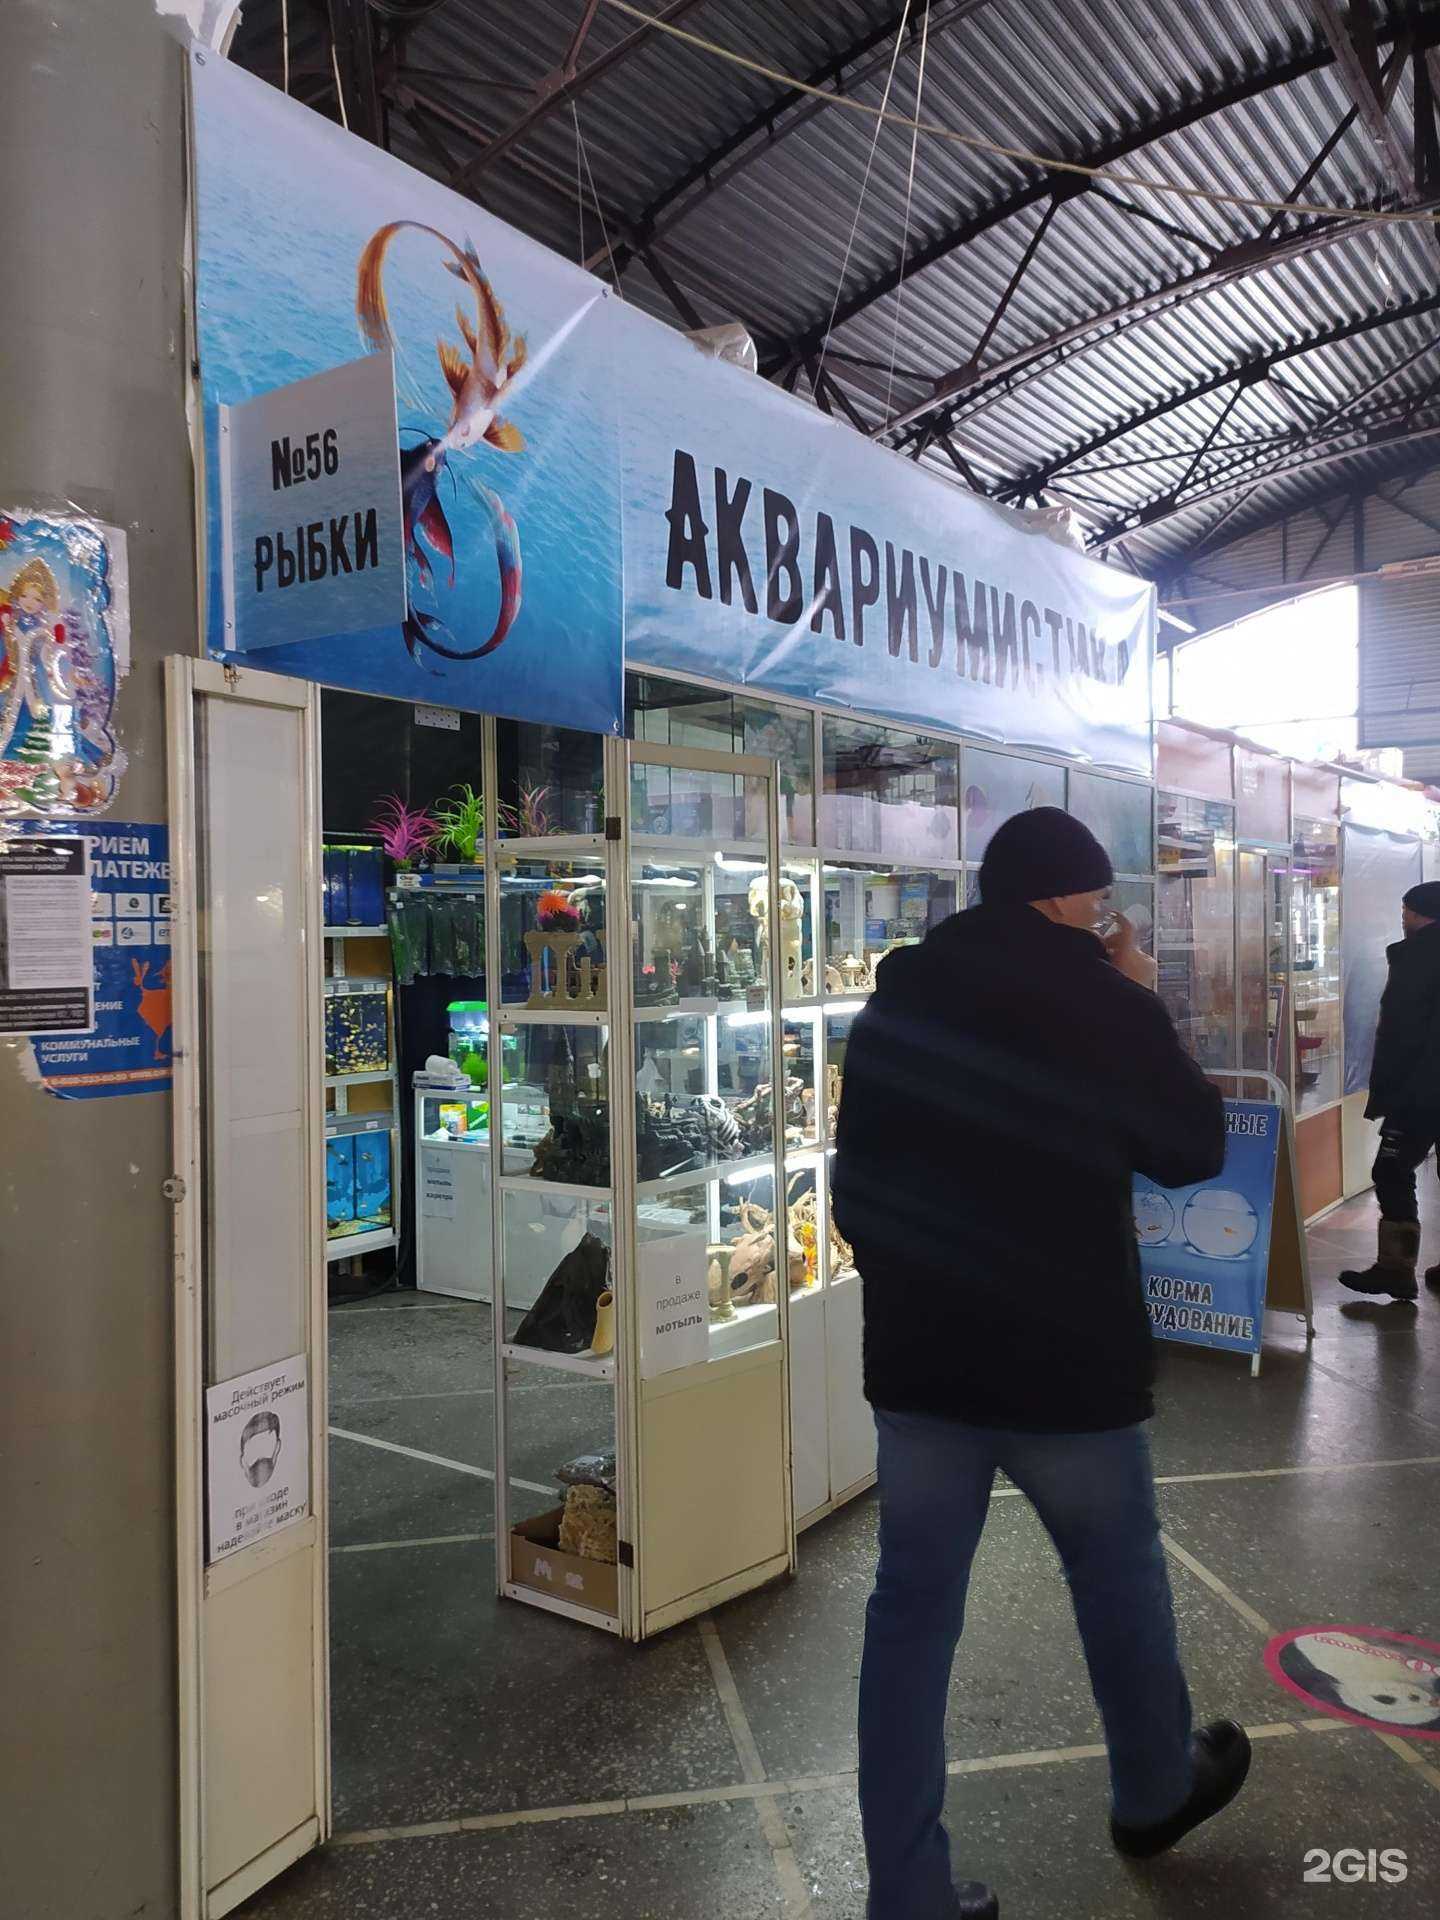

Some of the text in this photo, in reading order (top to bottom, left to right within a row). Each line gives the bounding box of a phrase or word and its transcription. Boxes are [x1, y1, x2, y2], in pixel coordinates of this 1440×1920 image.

[271, 428, 339, 491] №56
[254, 508, 379, 593] РЫБКИ
[41, 1036, 140, 1051] КОММУНАЛЬНЫЕ
[41, 1052, 89, 1064] УСЛУГИ
[656, 1290, 701, 1312] продаже
[1147, 1275, 1213, 1306] КОРМА
[656, 1315, 703, 1335] мотыль
[231, 1374, 286, 1405] Действует
[271, 1380, 305, 1404] режим
[276, 1502, 307, 1525] маску
